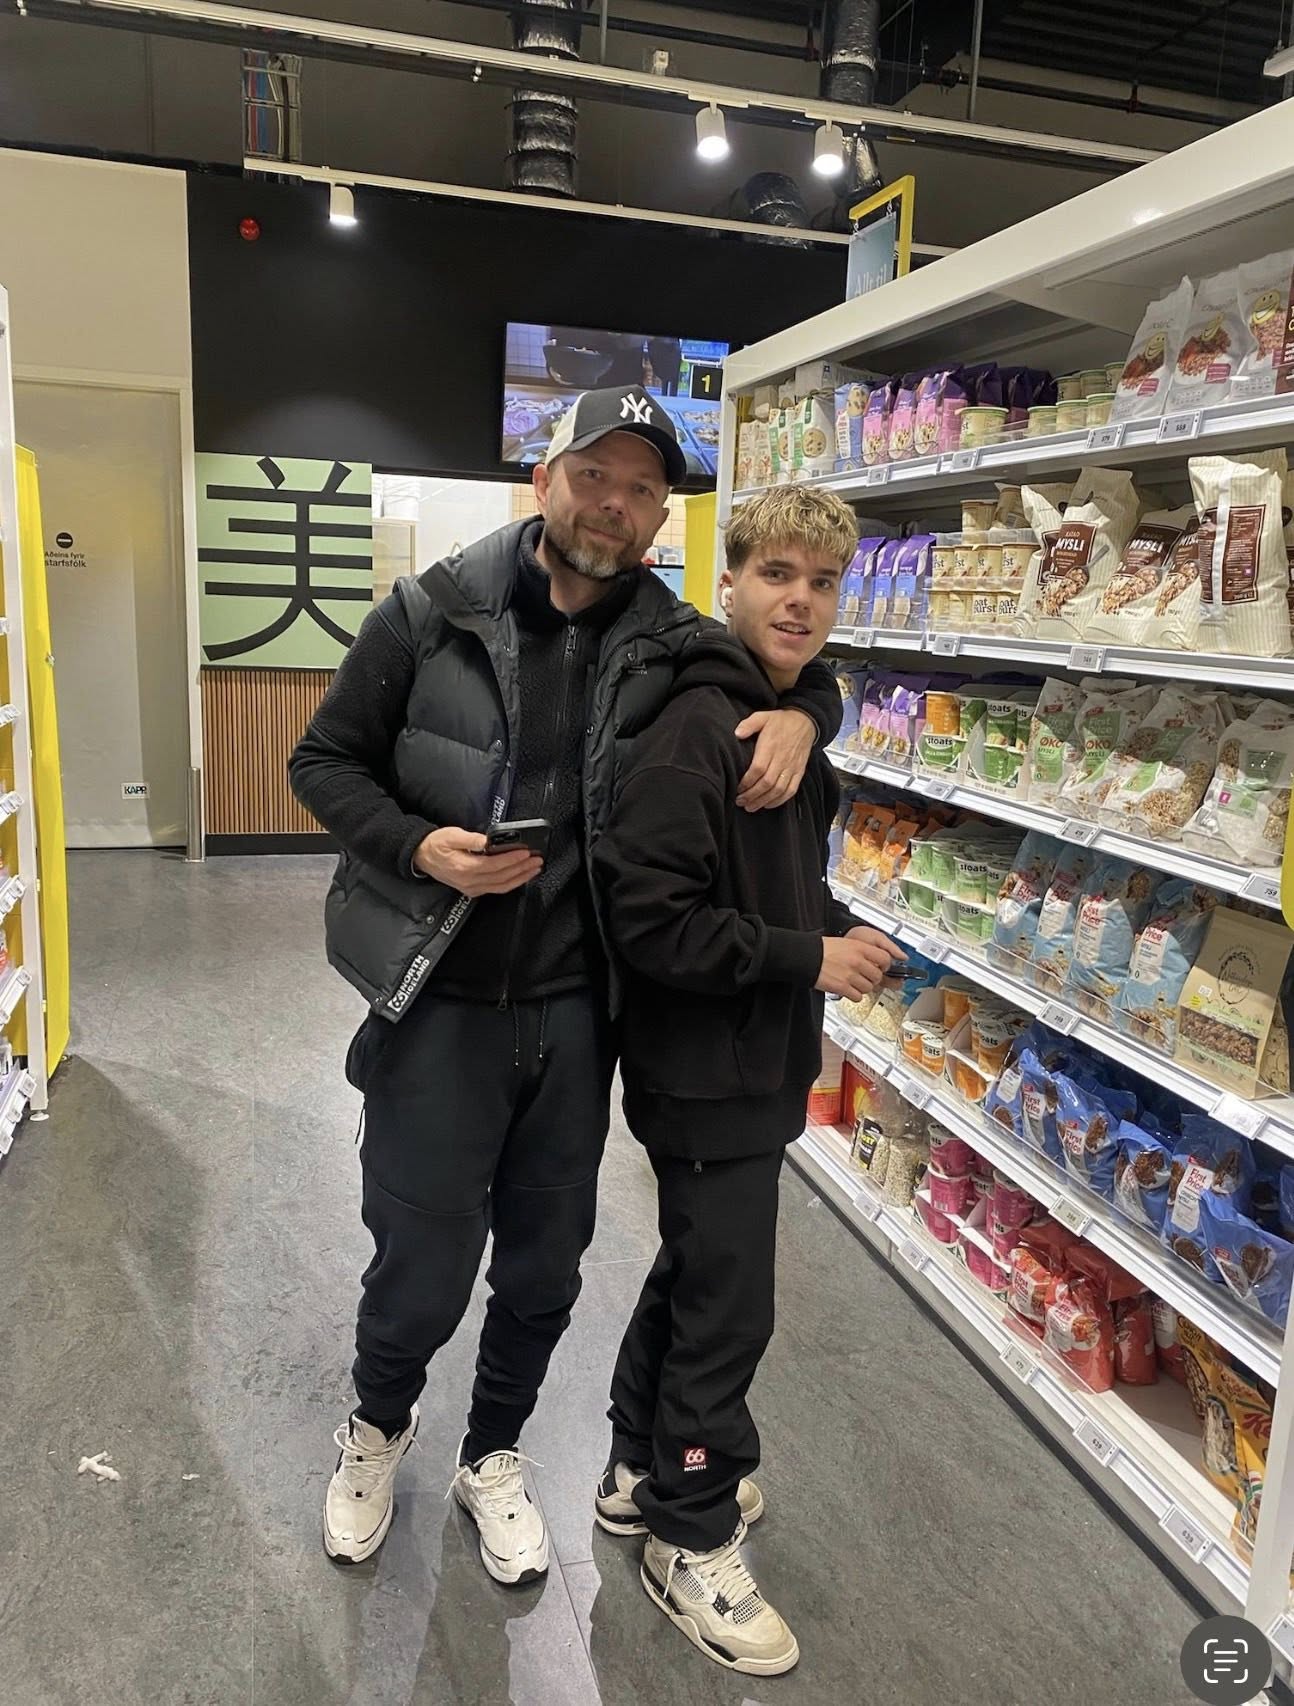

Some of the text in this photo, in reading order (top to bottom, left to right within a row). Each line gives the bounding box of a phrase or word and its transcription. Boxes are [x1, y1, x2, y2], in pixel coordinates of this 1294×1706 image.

[701, 374, 711, 393] 1
[620, 392, 653, 424] NY
[1055, 538, 1085, 551] MYSLI
[1128, 539, 1164, 553] MYSLI
[198, 456, 373, 661] 美
[400, 954, 424, 994] NORTH
[406, 959, 430, 996] ICELAND
[1190, 1168, 1207, 1182] First
[685, 1448, 705, 1464] 66
